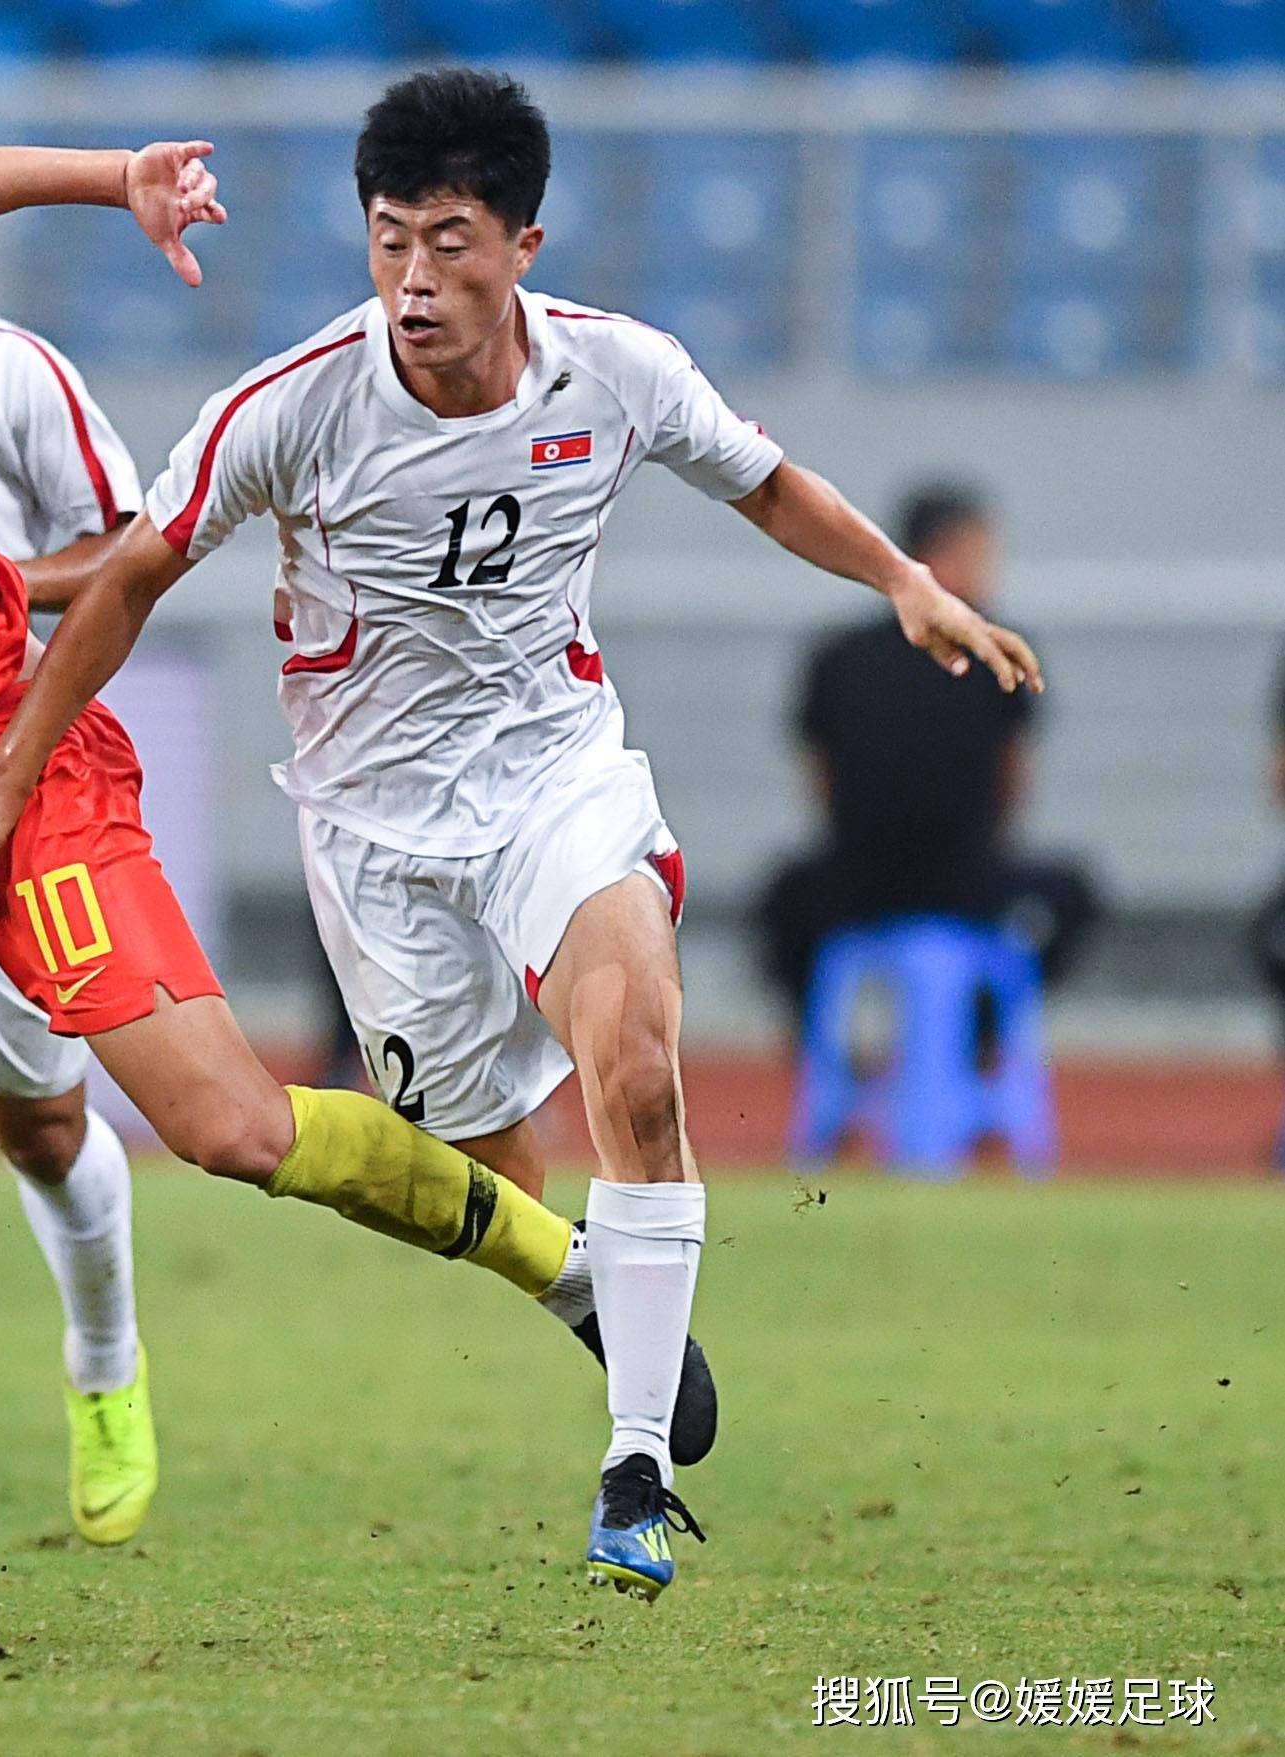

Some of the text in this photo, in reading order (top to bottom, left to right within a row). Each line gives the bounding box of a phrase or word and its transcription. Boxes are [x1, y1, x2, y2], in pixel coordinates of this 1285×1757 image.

[427, 494, 521, 588] 12
[15, 863, 113, 974] 10
[364, 1034, 426, 1124] 2
